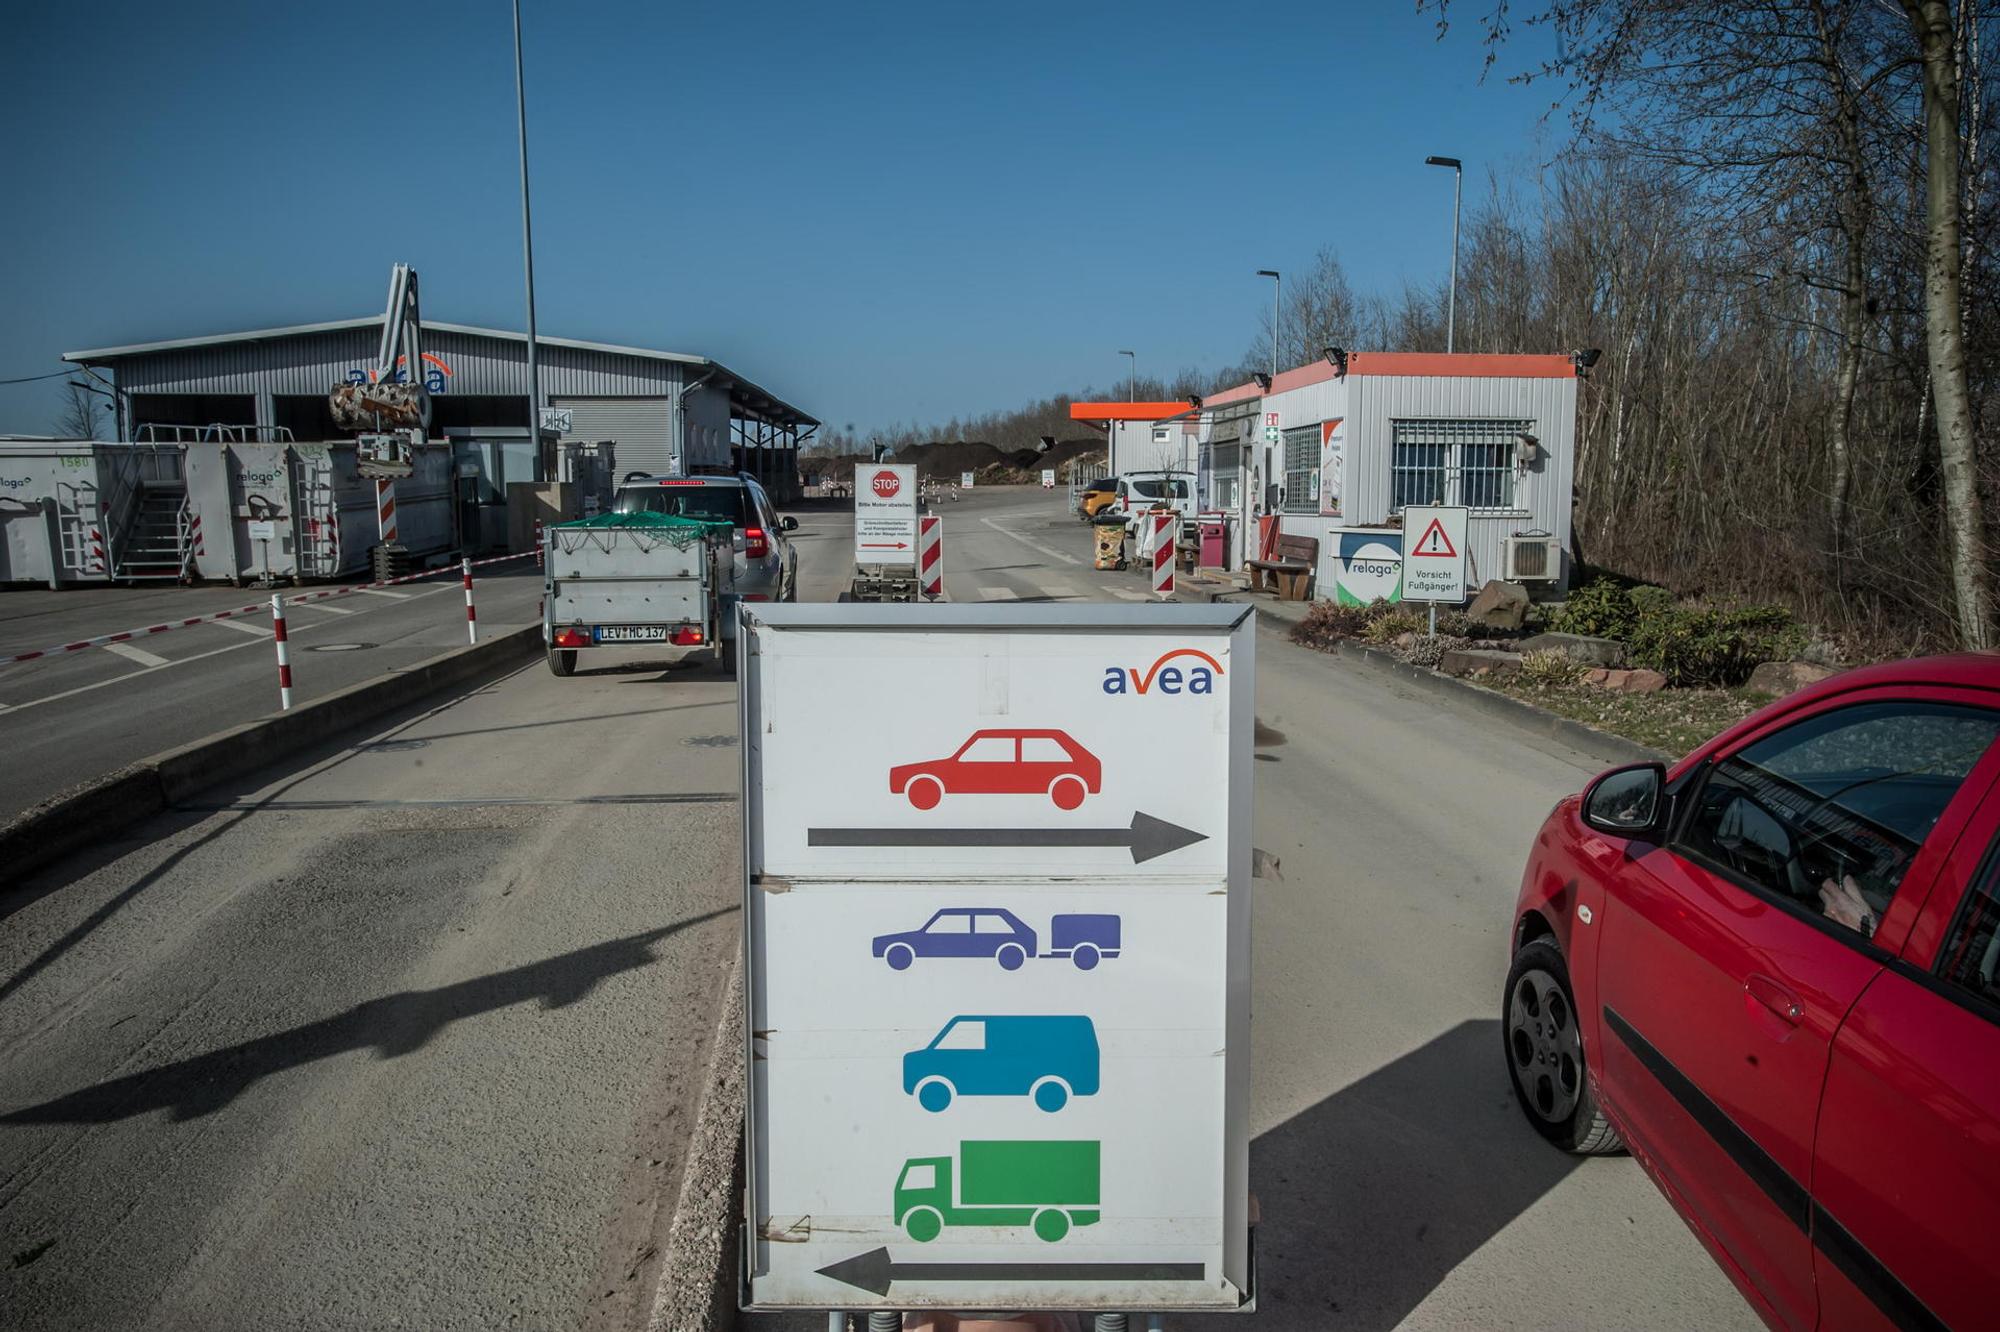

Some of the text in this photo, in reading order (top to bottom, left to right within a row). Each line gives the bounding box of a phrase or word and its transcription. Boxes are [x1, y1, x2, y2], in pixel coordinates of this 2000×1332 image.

[873, 479, 899, 490] STOP
[1353, 560, 1392, 577] reloga
[1416, 570, 1452, 579] Vorsicht
[1408, 580, 1459, 592] Fußgänger!
[601, 626, 621, 639] LEV
[645, 626, 665, 638] 137
[1103, 649, 1223, 694] avea
